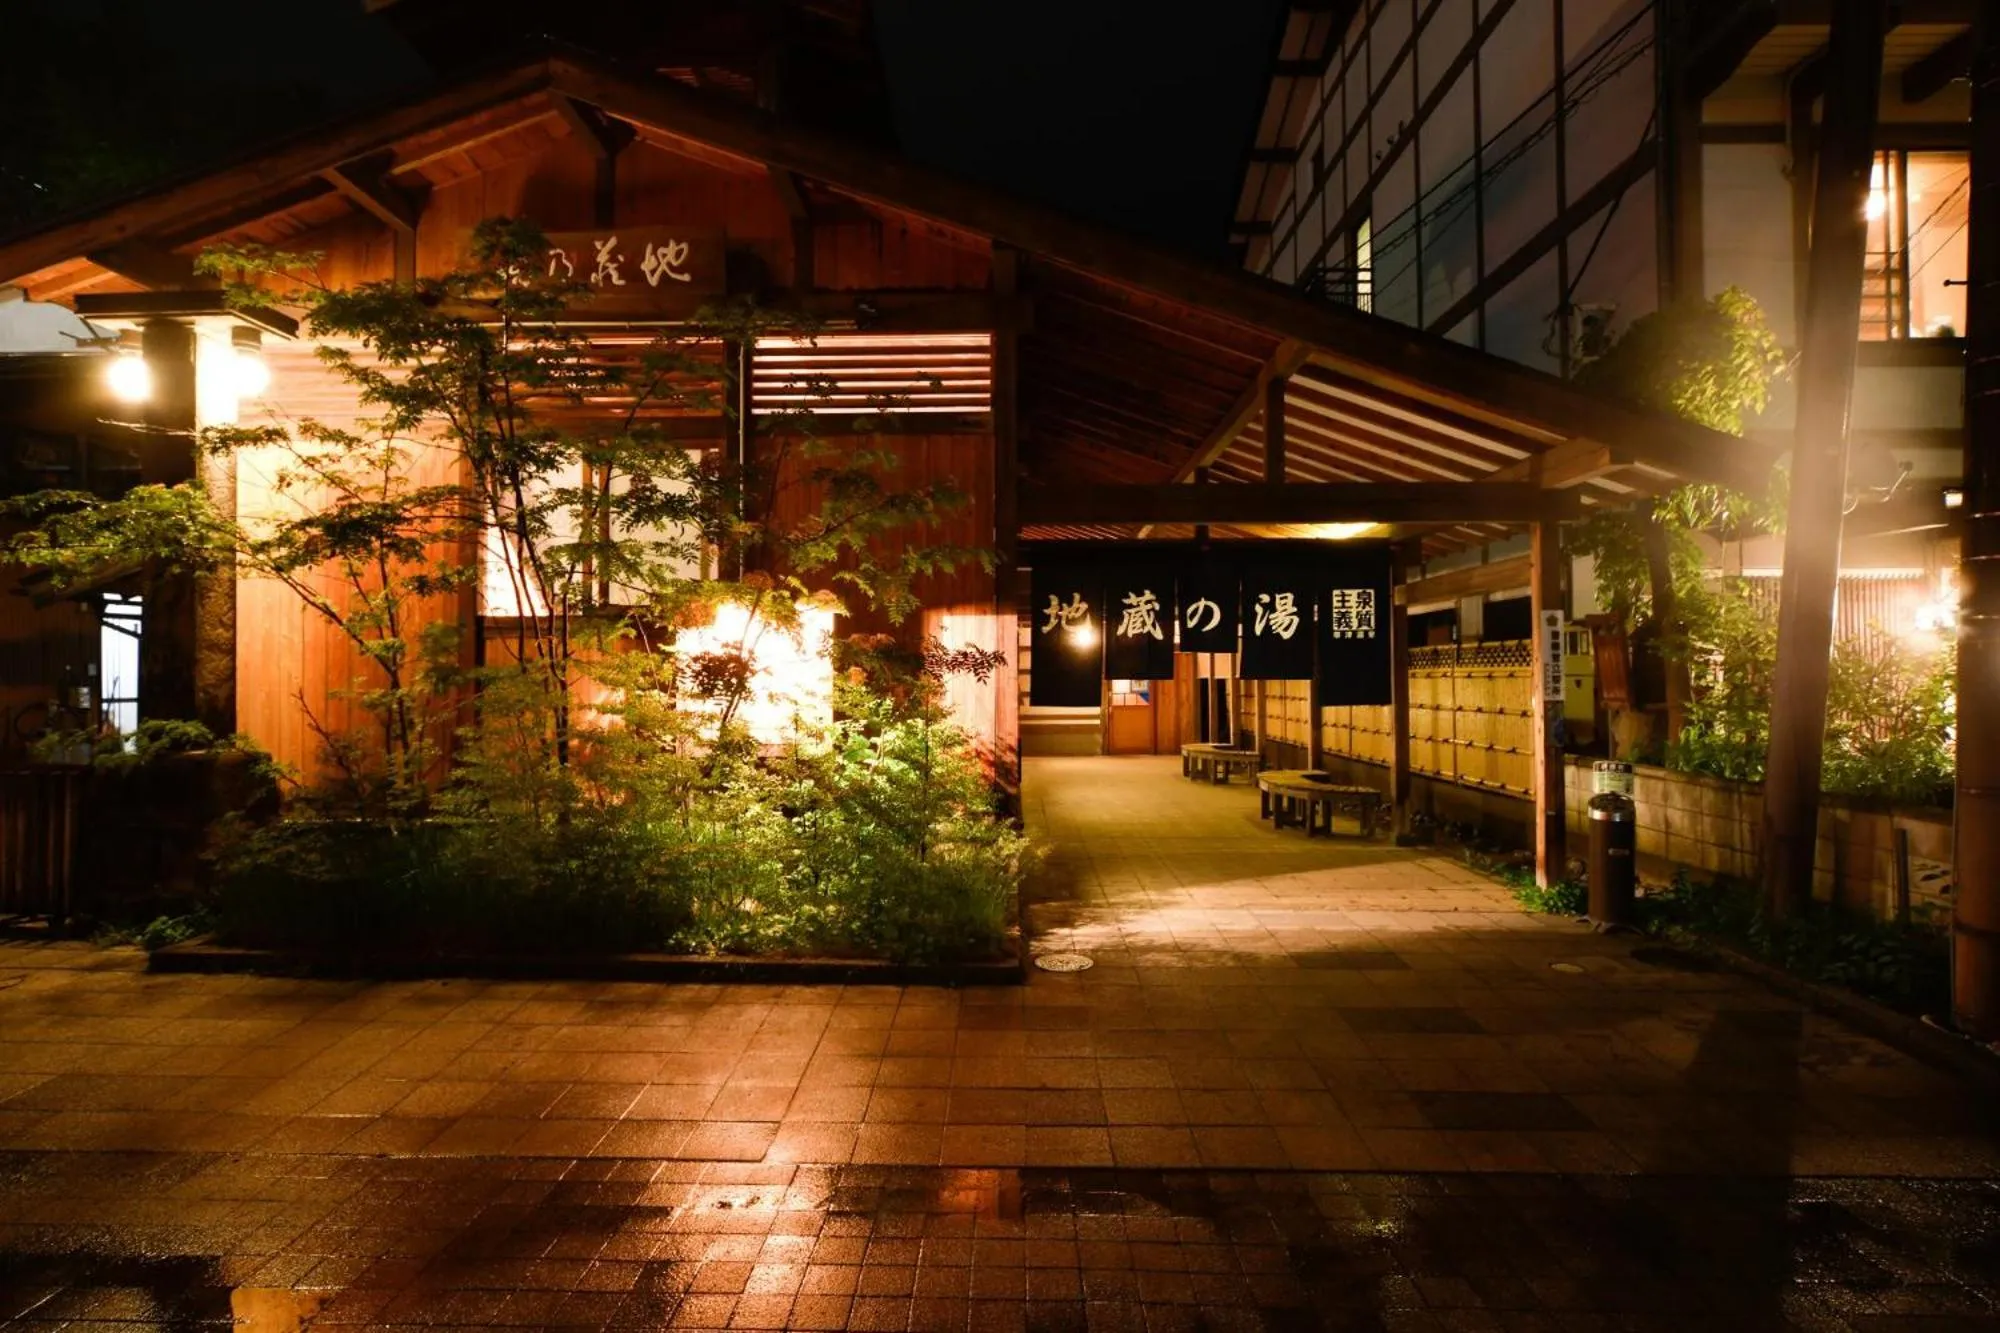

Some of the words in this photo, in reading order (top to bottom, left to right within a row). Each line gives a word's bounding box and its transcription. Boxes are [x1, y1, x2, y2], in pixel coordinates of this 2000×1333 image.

[497, 236, 692, 288] 地蔵乃
[1042, 589, 1300, 641] 地蔵の湯
